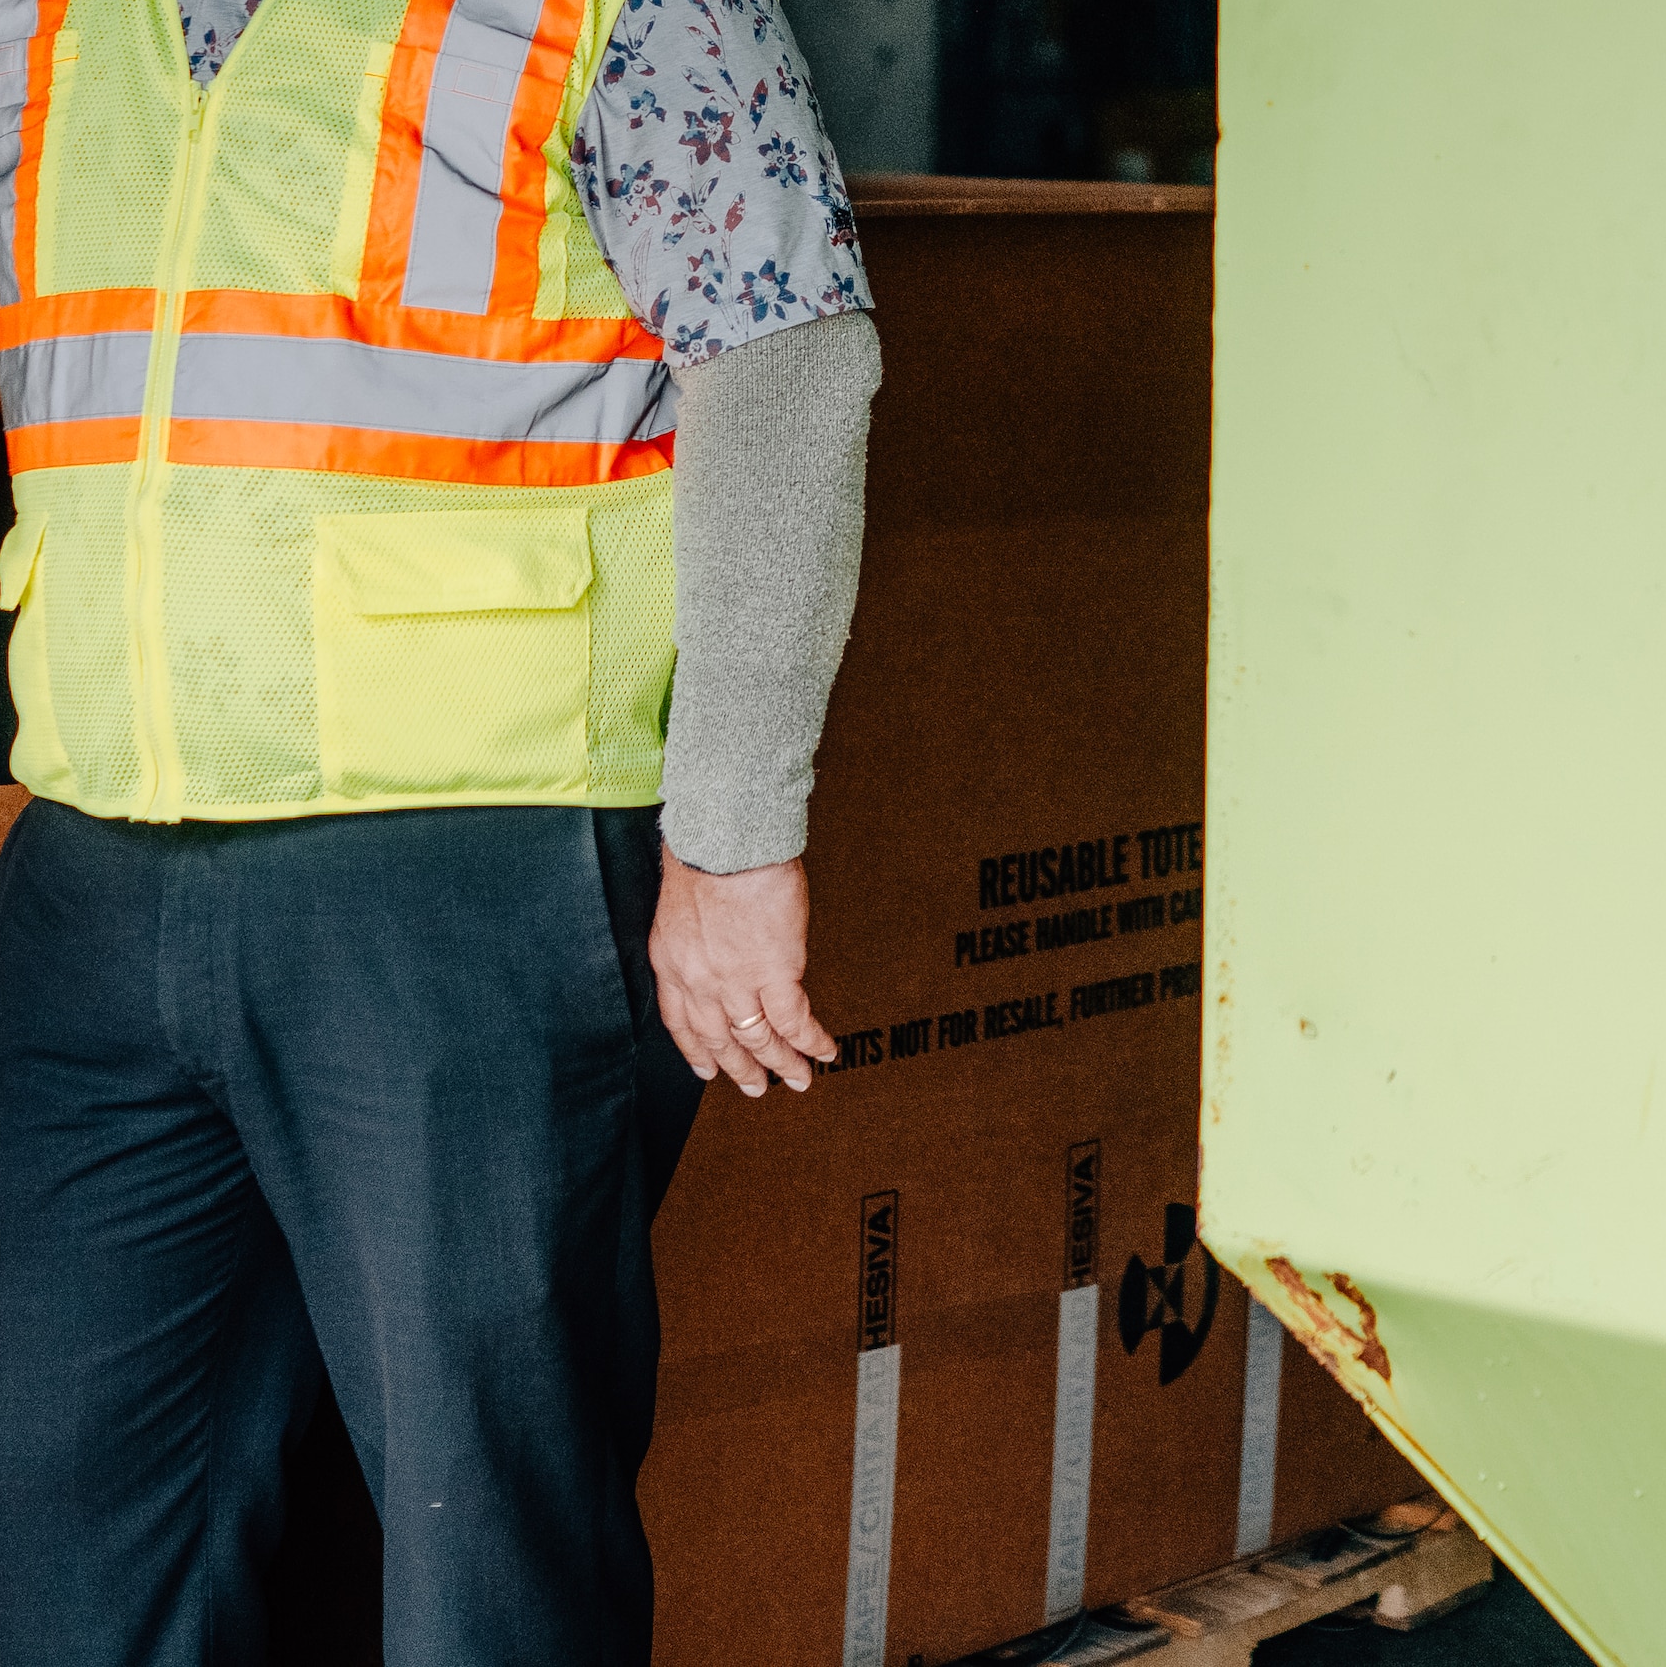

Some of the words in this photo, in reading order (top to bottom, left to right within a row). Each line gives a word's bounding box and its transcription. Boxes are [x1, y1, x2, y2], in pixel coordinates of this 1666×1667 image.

[979, 834, 1130, 910] REUSABLE
[1137, 821, 1202, 880] TOTE
[954, 920, 1030, 968] PLEASE
[1035, 903, 1113, 951] HANDLE
[1116, 894, 1165, 933] WITH
[889, 1019, 933, 1061] NOT
[937, 1009, 978, 1051] FOR
[983, 992, 1064, 1042] RESALE,
[1070, 971, 1155, 1021] FURTHER
